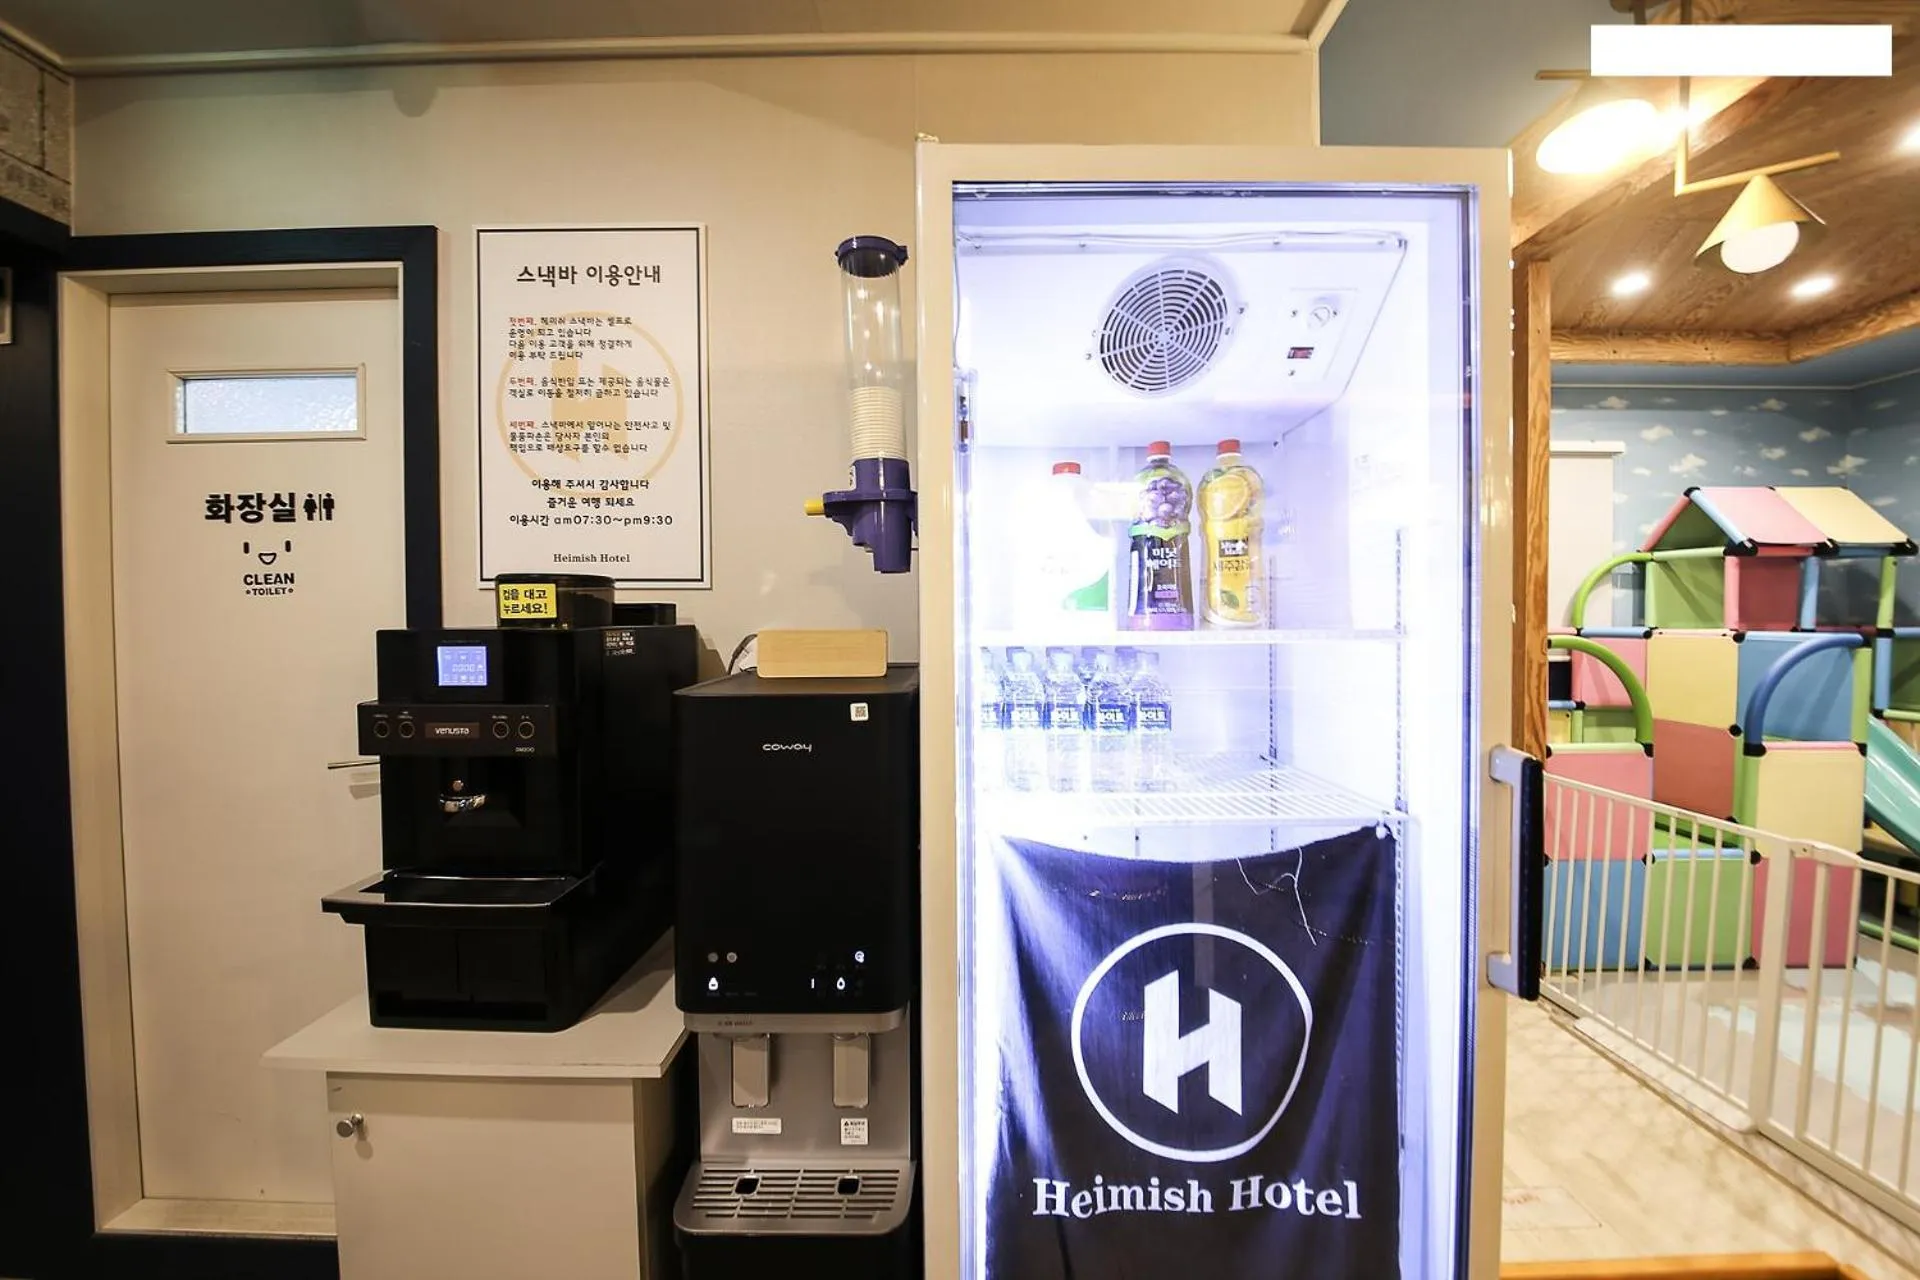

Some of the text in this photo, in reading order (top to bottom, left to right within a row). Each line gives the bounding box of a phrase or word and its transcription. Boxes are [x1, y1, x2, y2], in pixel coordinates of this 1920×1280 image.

[516, 264, 660, 288] 스낵바 이용안내
[569, 317, 602, 326] 스낵바는
[607, 317, 632, 326] 셀프로
[508, 328, 592, 338] 운영이 되고 있습니다
[509, 340, 526, 350] 다음
[529, 340, 545, 350] 이용
[549, 340, 574, 350] 고객을
[578, 340, 595, 350] 위해
[508, 351, 583, 361] 이용 부탁 드립니다
[509, 376, 671, 386] 두번째. 음식반입 또는 제공되는 음식물은
[508, 388, 659, 398] 객실로 이동을 철저히 금하고 있습니다
[541, 420, 584, 430] 스낵바에서
[587, 420, 621, 430] 일어나는
[624, 420, 659, 430] 안전사고
[662, 420, 671, 430] 및
[509, 432, 610, 442] 물품파손은 당사자 본인의
[509, 444, 648, 454] 책임으로 배상요구를 할수 없습니다
[532, 479, 650, 490] 이용해 주셔서 감사합니다
[546, 497, 635, 508] 즐거운 여행 되세요
[204, 492, 297, 524] 화장실
[509, 515, 550, 526] 이용시간
[553, 553, 631, 563] Heimish Hotel
[243, 573, 295, 586] CLEAN
[251, 587, 288, 596] TOILET
[524, 588, 548, 600] 대고
[503, 602, 548, 615] 누르세요!
[762, 743, 813, 753] coway
[1143, 969, 1243, 1117] H
[1032, 1174, 1363, 1220] Heimish Hotel
